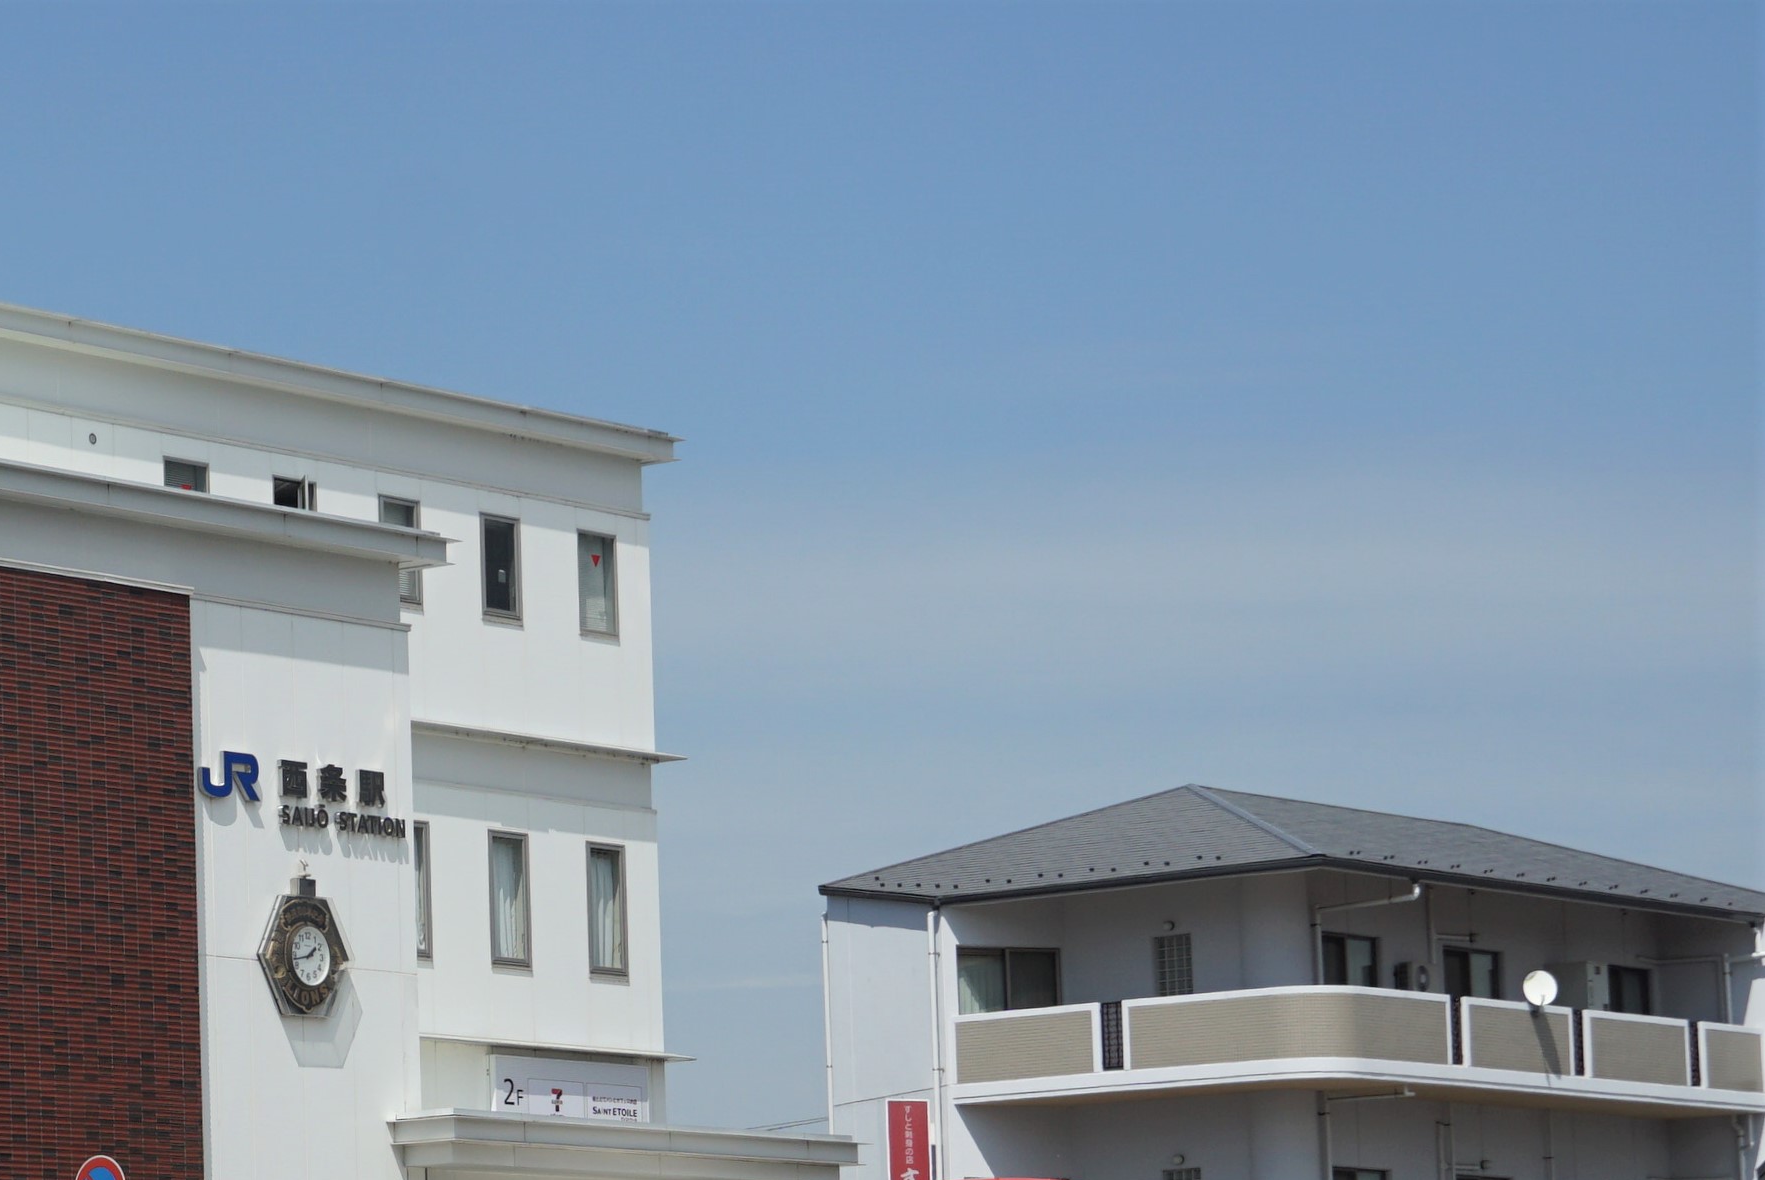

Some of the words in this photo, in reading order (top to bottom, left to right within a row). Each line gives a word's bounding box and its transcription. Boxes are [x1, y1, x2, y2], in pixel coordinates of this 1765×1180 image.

[198, 750, 260, 801] JR
[277, 758, 386, 808] 西条駅
[335, 811, 406, 838] STATION
